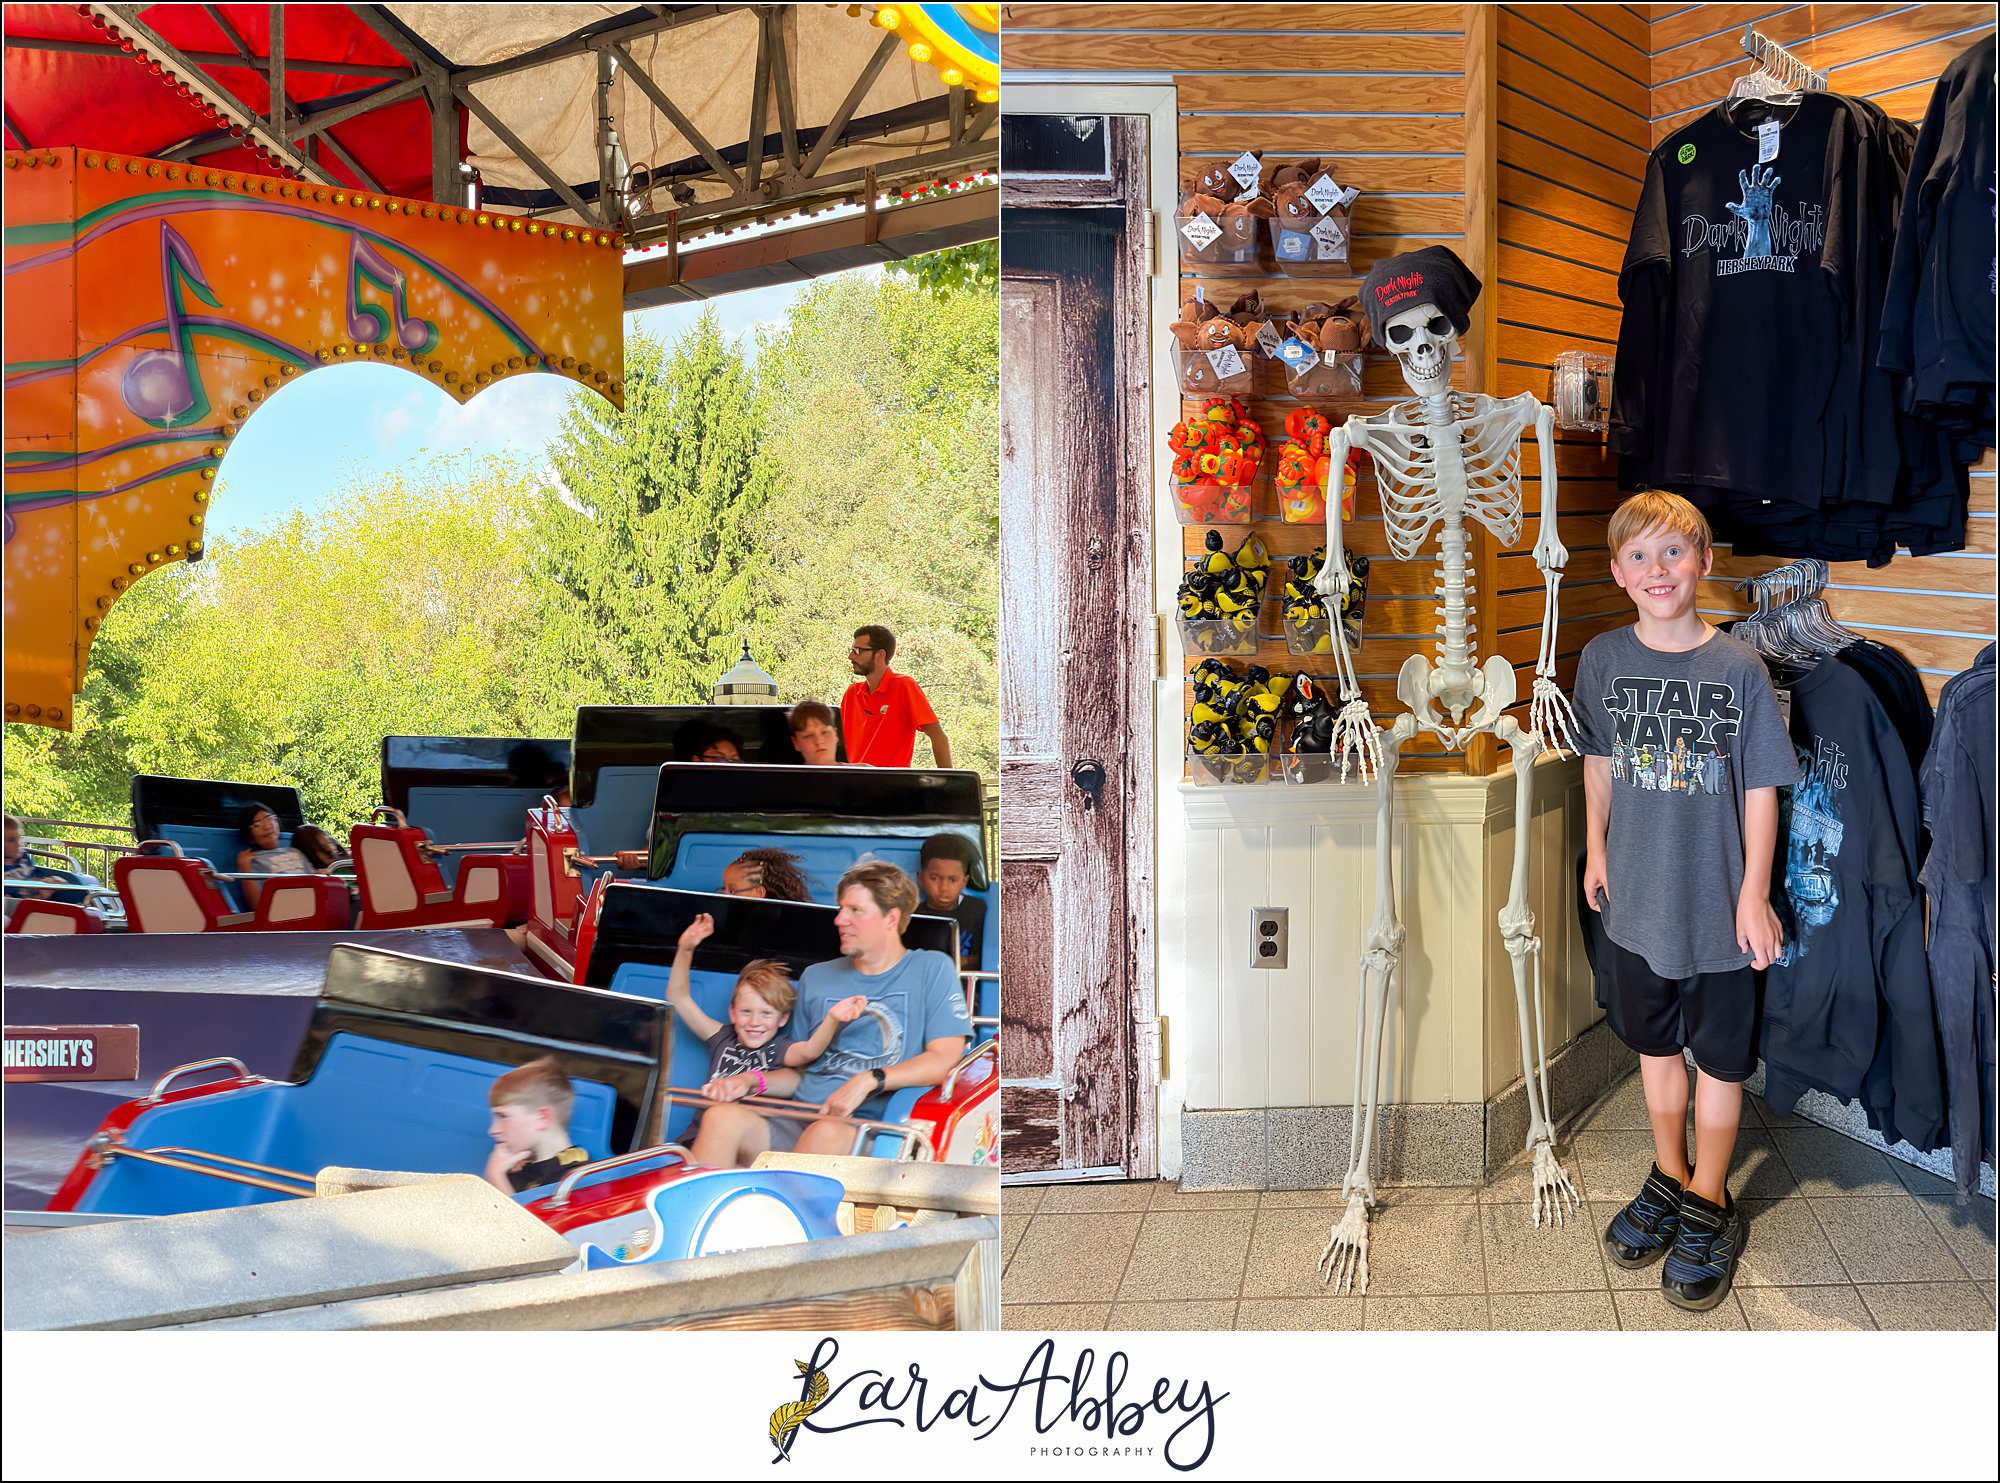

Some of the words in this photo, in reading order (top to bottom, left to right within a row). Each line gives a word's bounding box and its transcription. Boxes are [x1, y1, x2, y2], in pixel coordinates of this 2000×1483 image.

[1681, 214, 1749, 258] Dark
[1716, 255, 1796, 277] HERSHEYPARK
[1375, 277, 1402, 303] Dark
[1396, 271, 1424, 291] Nights
[1602, 676, 1743, 723] STAR
[1796, 735, 1849, 795] ghts
[4, 1039, 93, 1067] HERSHEY'S
